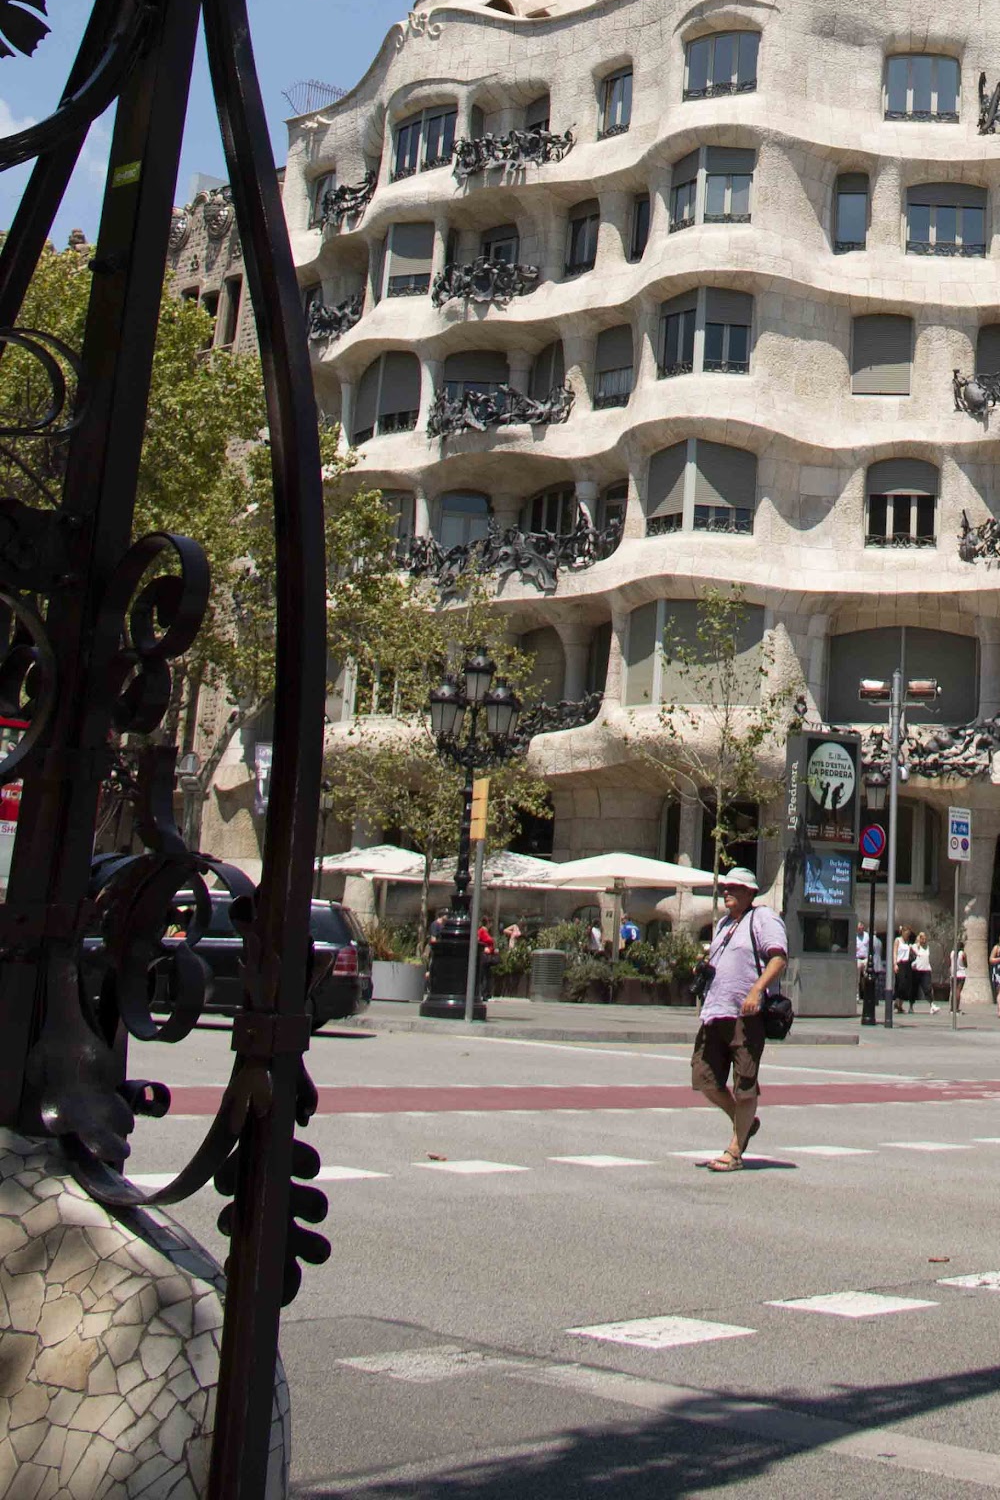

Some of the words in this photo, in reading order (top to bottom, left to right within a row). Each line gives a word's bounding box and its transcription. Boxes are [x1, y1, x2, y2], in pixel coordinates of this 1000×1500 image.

[809, 767, 818, 775] LA
[820, 768, 853, 779] PEDRERA
[788, 760, 798, 815] Pedrera
[788, 816, 798, 830] La
